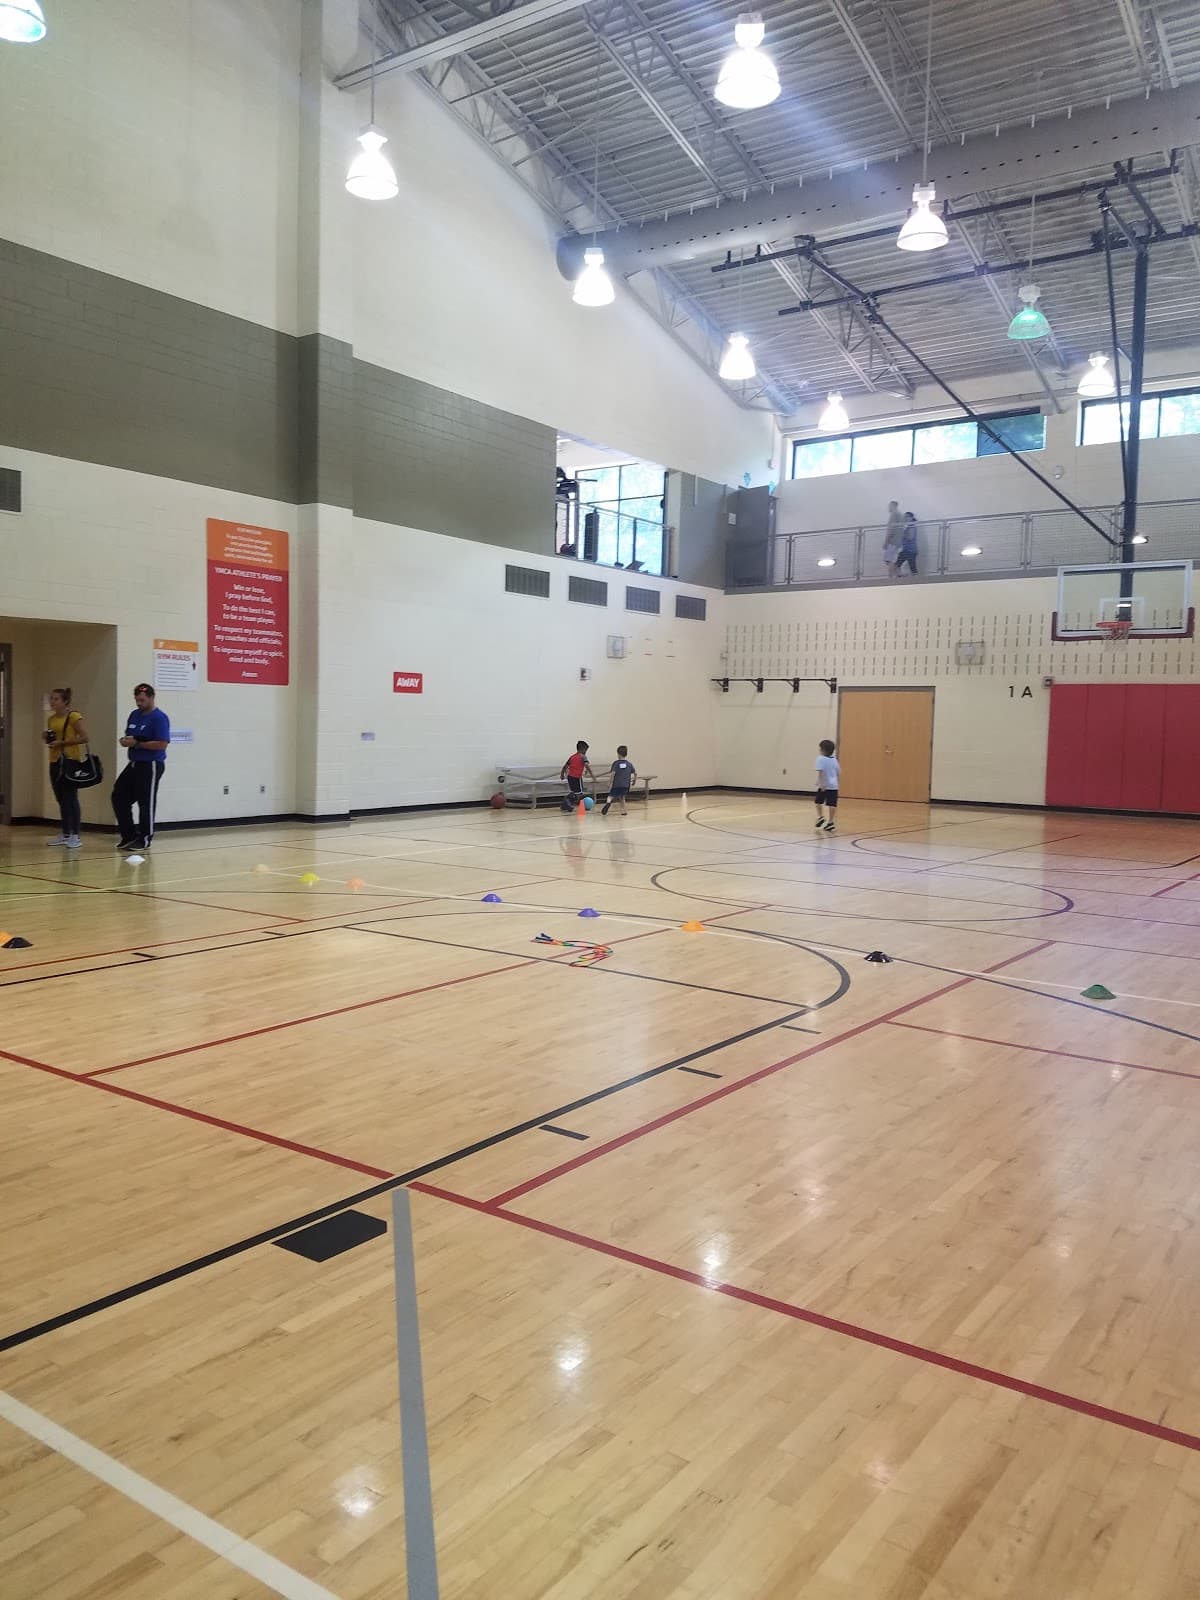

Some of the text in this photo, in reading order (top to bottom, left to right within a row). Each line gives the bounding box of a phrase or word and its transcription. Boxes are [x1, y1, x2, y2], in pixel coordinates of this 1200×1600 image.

[215, 567, 232, 575] YMCA
[242, 594, 260, 602] before
[396, 678, 420, 688] AWAY
[1008, 686, 1032, 698] 1 A
